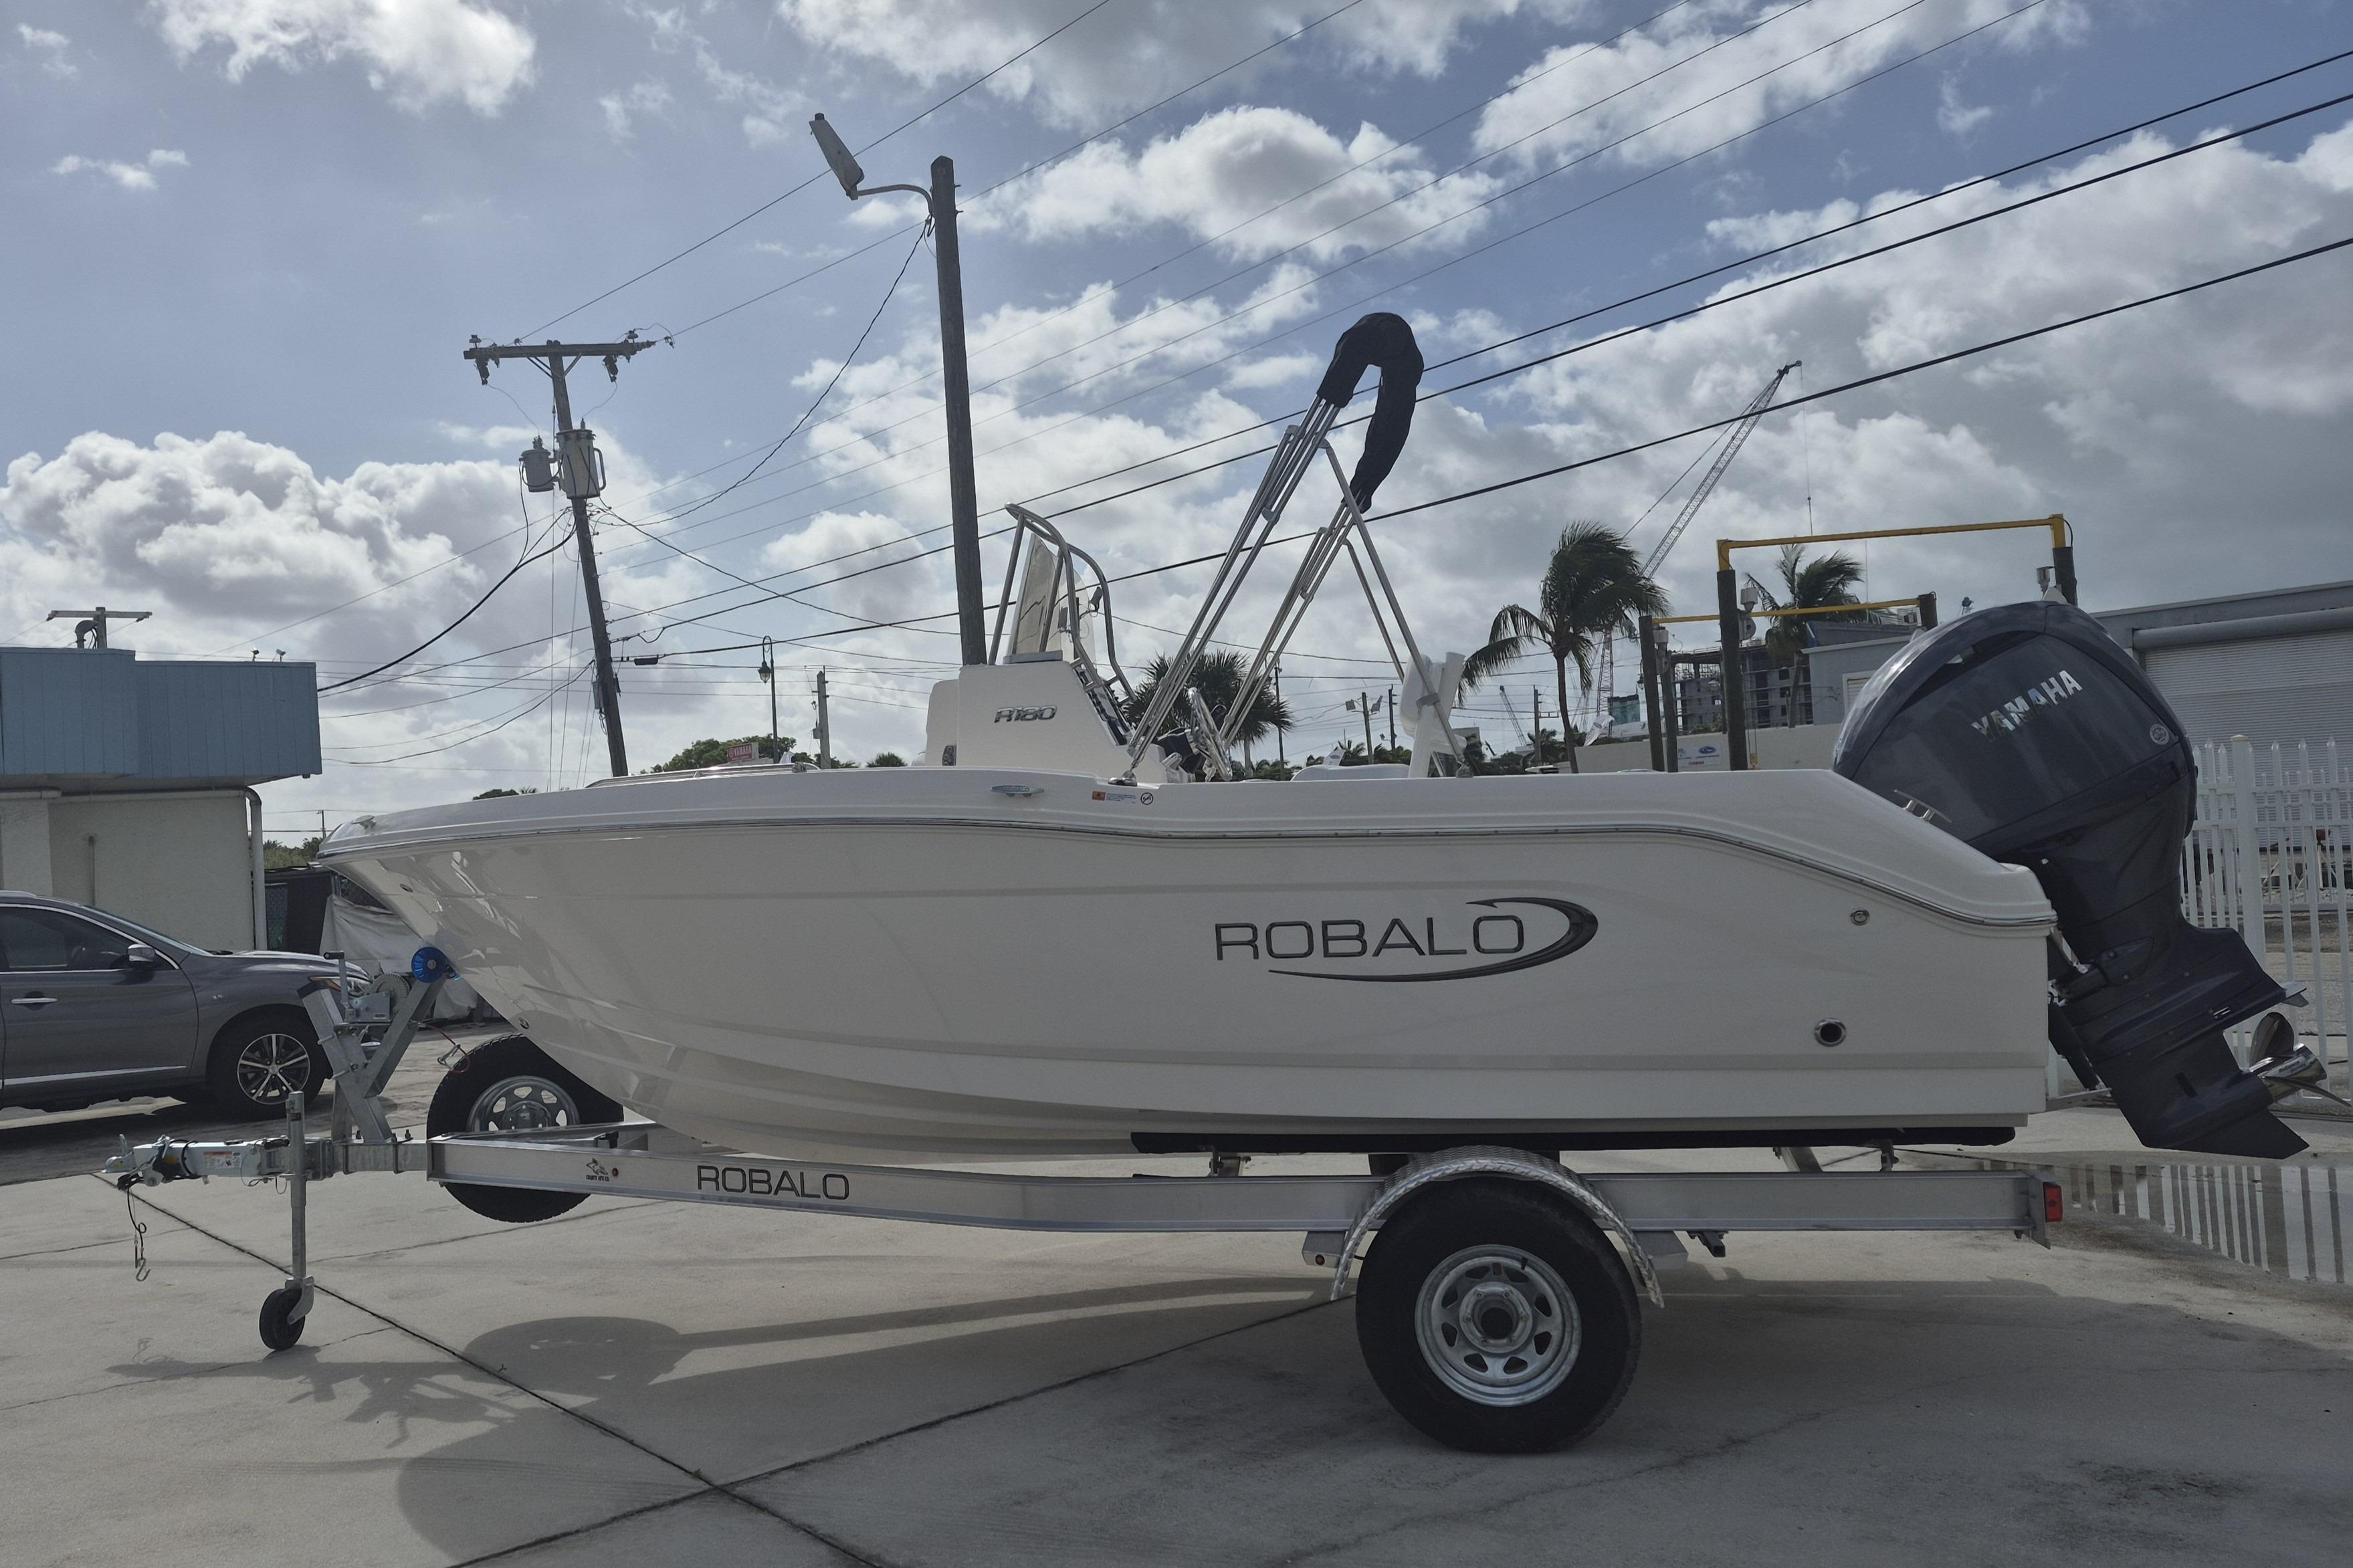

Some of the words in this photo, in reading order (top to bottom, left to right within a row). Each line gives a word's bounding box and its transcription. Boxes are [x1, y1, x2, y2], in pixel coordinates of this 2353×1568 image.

[994, 705, 1057, 723] R180
[1971, 670, 2083, 743] YAMAHA
[734, 745, 752, 756] YAMAHA
[1215, 915, 1525, 960] ROBALO
[697, 1165, 849, 1200] ROBALO
